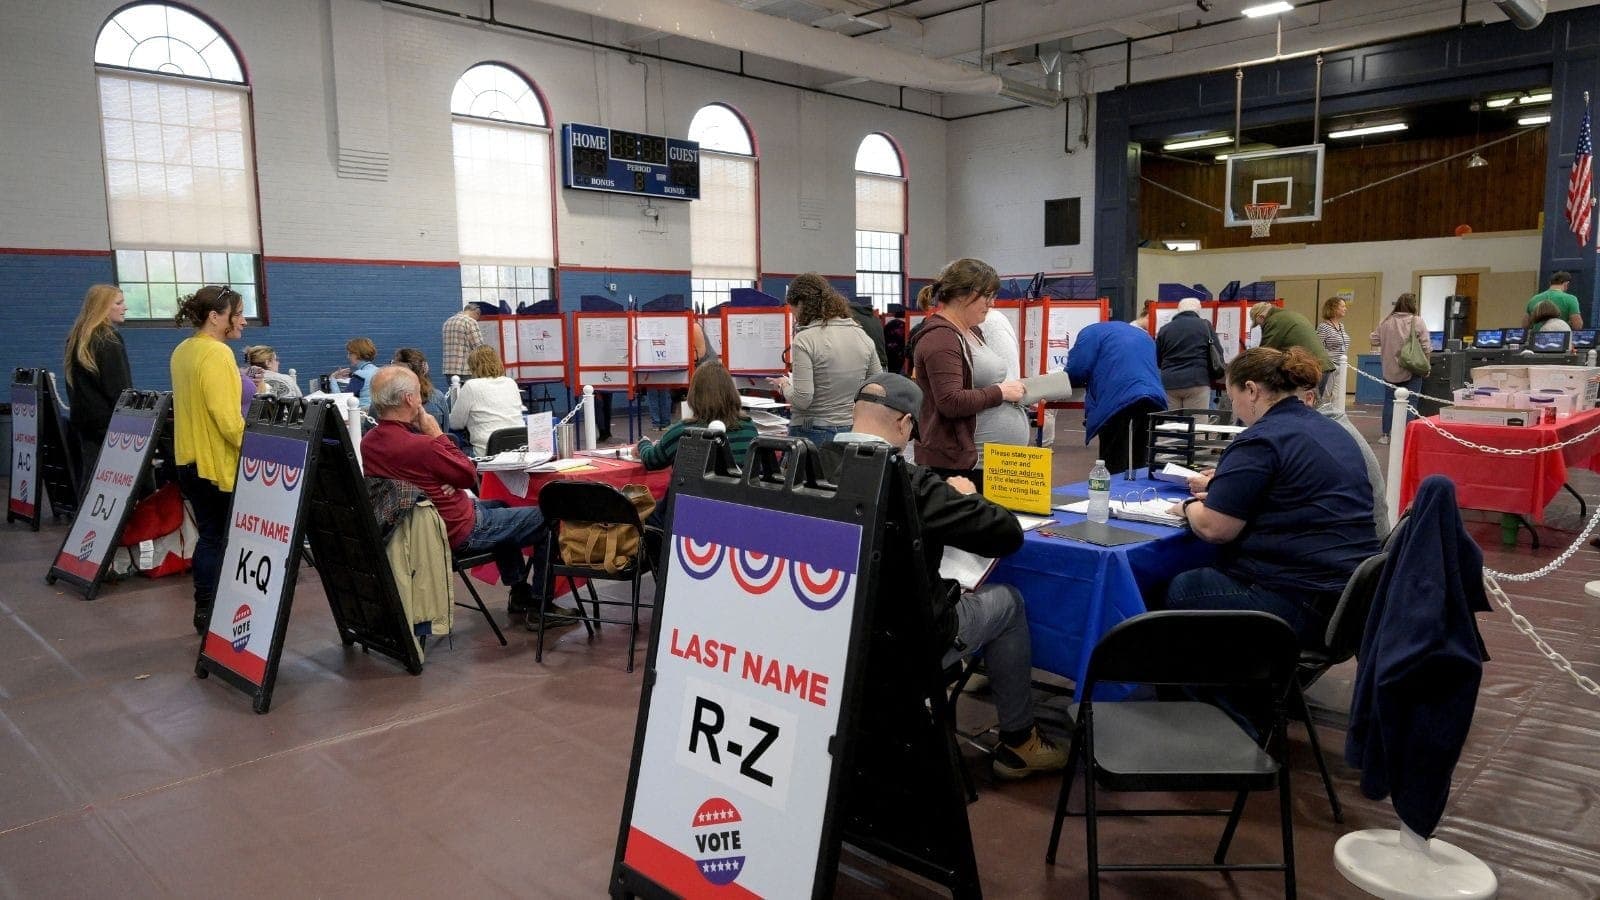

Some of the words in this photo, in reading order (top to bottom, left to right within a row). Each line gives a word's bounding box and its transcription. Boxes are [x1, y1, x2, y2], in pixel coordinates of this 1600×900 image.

[572, 132, 608, 151] HOME
[669, 147, 698, 163] GUEST
[626, 164, 652, 173] PERIOD
[591, 178, 615, 187] BONUS
[664, 186, 686, 195] BONUS
[17, 451, 31, 472] A-C
[990, 448, 1010, 457] Please
[1011, 451, 1027, 459] state
[1027, 453, 1044, 461] your
[96, 469, 114, 482] LAST
[112, 472, 134, 487] NAME
[988, 467, 1018, 476] residence
[1018, 470, 1044, 478] address
[1004, 477, 1029, 485] election
[1008, 486, 1029, 496] voting
[91, 493, 117, 521] D-J
[235, 511, 261, 534] LAST
[259, 518, 290, 544] NAME
[235, 547, 272, 596] K-Q
[232, 620, 251, 638] VOTE
[670, 628, 737, 673] LAST
[741, 651, 829, 707] NAME
[688, 696, 782, 788] R-Z
[694, 830, 742, 853] VOTE
